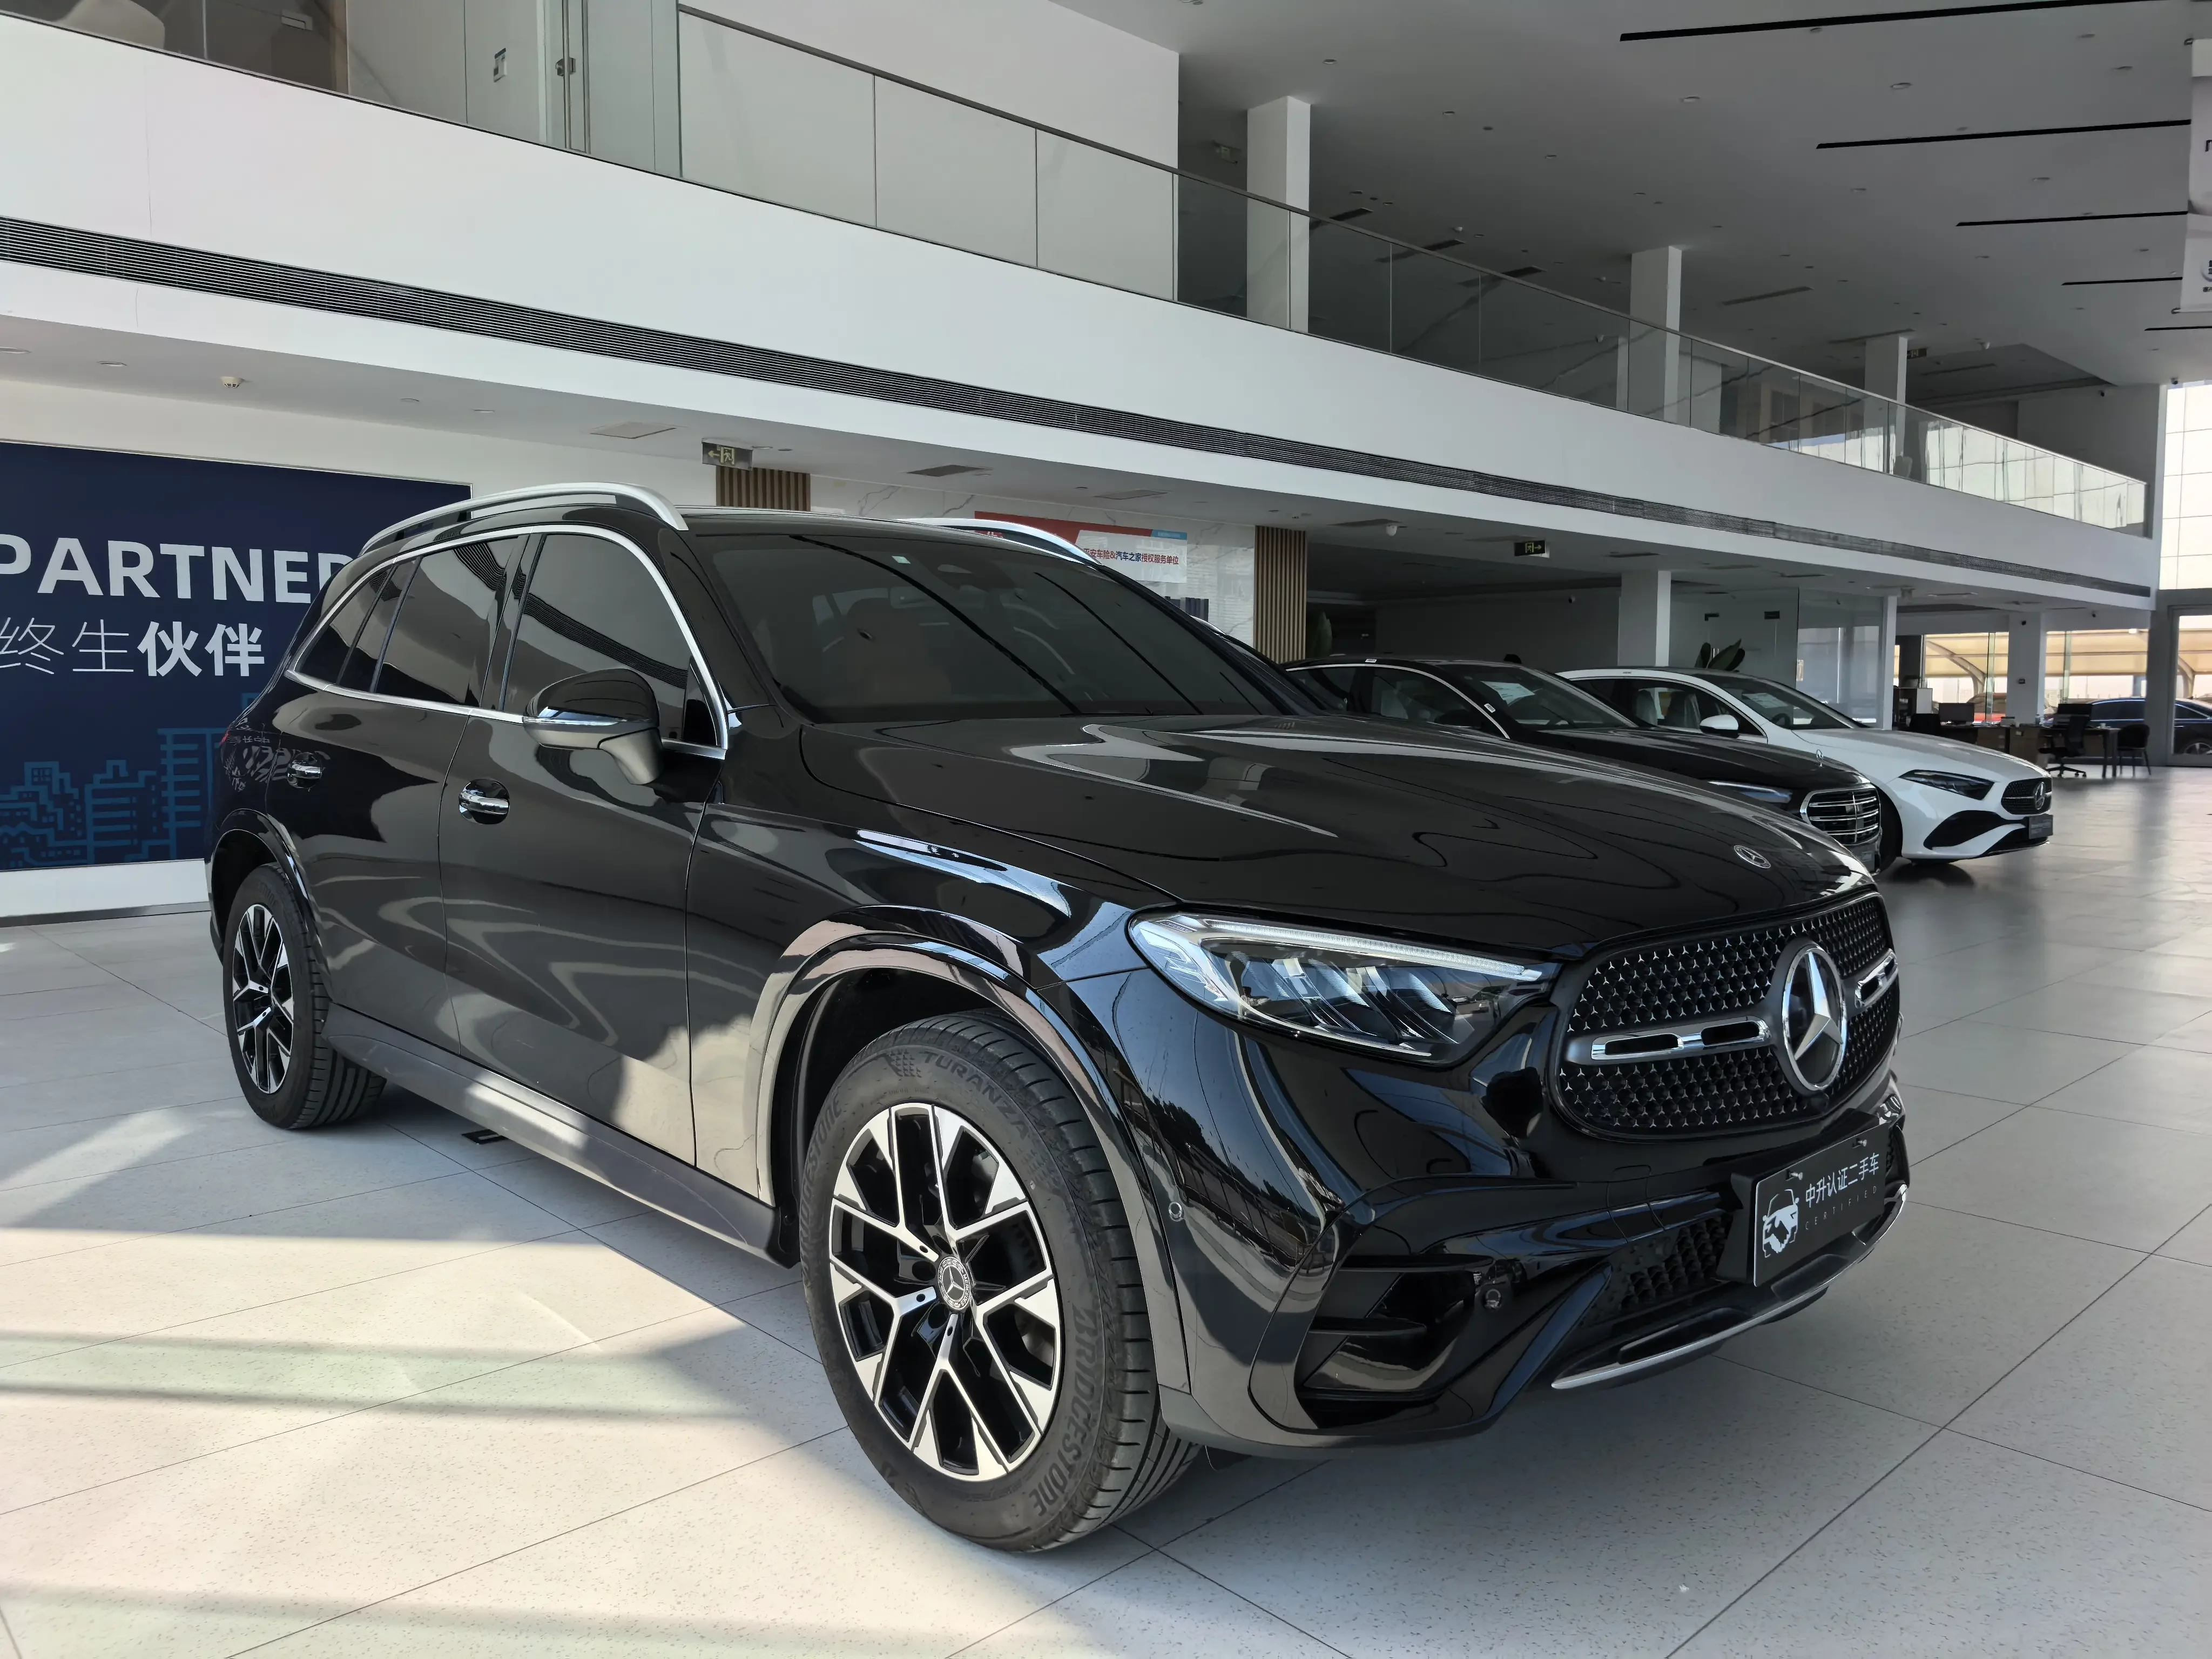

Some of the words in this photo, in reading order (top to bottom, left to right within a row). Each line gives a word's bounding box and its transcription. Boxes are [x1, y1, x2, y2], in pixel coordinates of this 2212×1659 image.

[919, 1051, 1030, 1141] TURANZA
[1805, 1186, 1877, 1230] CERTIFIED
[1806, 1152, 1879, 1208] 中升认证二手车
[961, 1273, 969, 1306] MERCEDES
[1029, 1303, 1097, 1516] BRIDGESTONE
